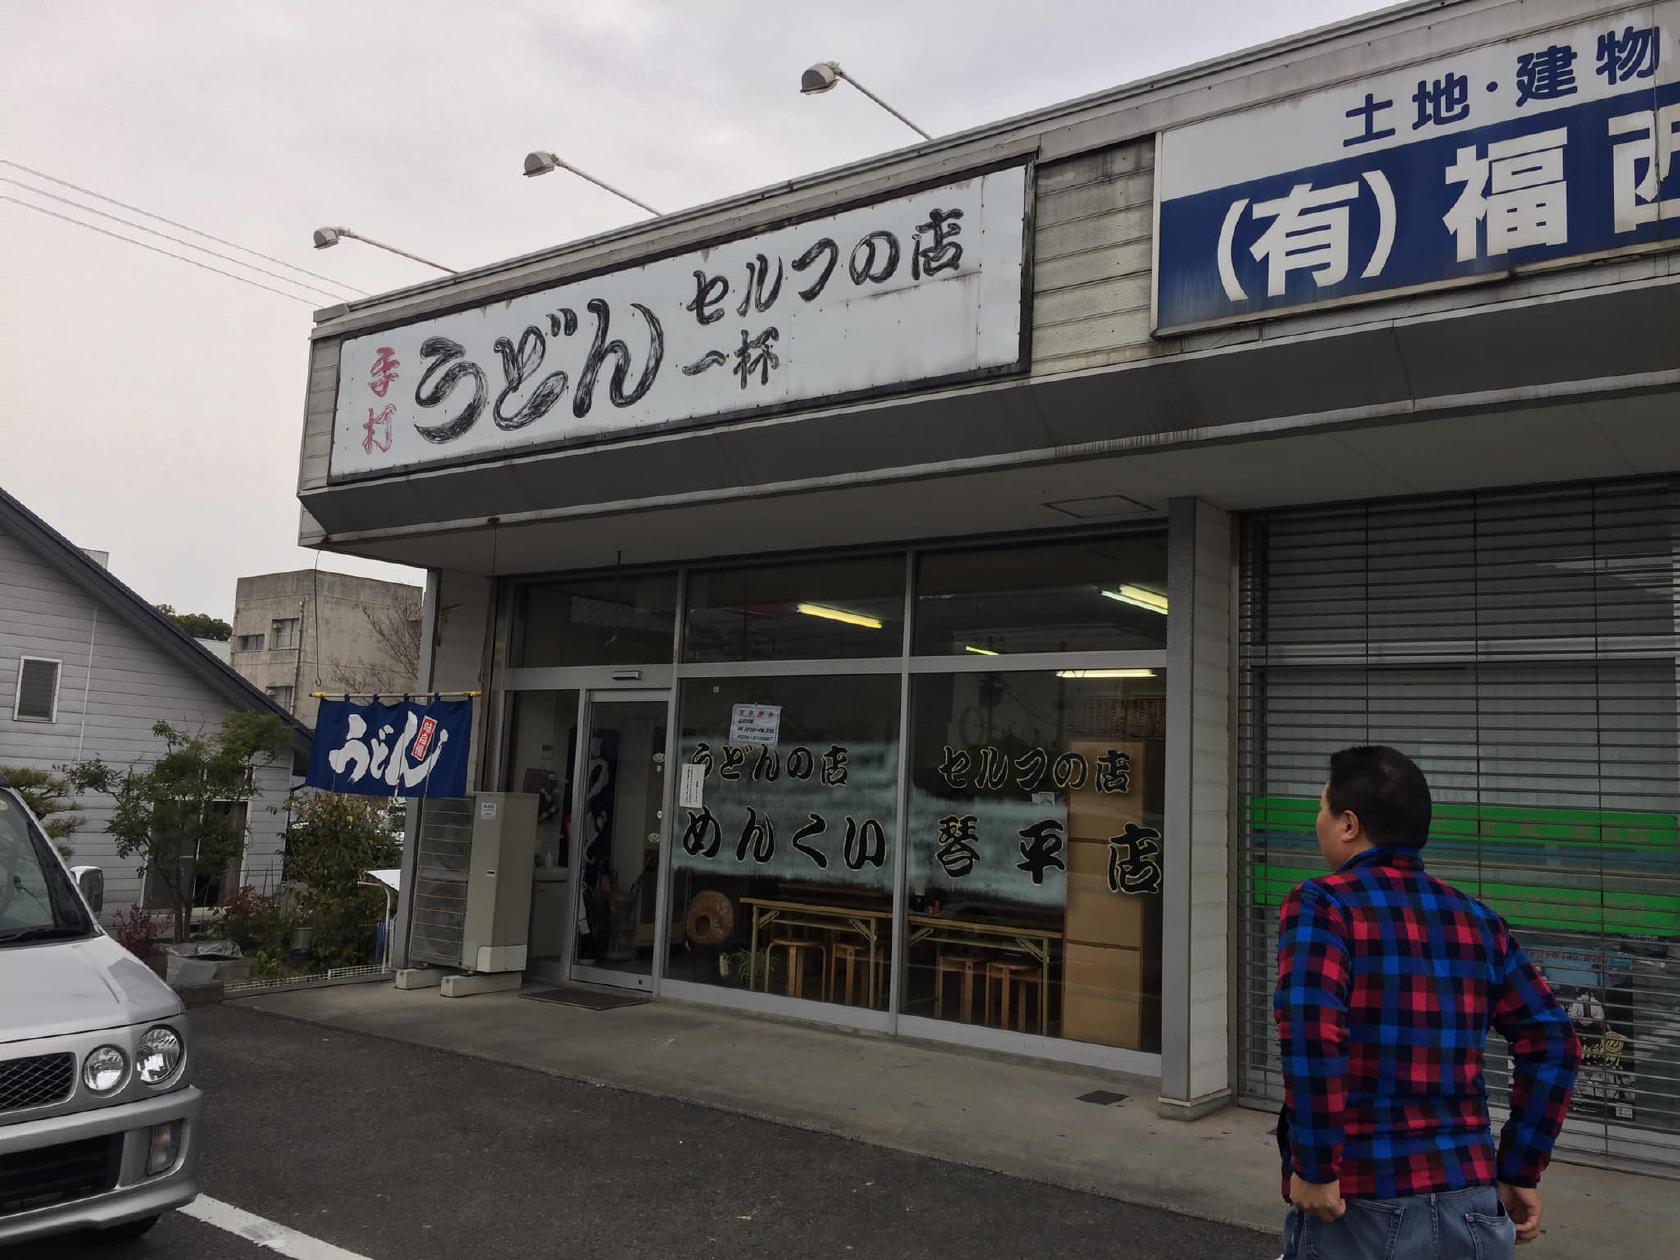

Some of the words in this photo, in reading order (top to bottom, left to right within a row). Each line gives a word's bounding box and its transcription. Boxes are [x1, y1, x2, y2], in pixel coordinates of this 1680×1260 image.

[1343, 26, 1660, 147] 土地・建物
[413, 298, 664, 444] うどん
[682, 327, 779, 389] 一杯
[328, 710, 448, 788] うどん
[691, 741, 849, 787] うどんの店
[682, 805, 887, 872] めんくい
